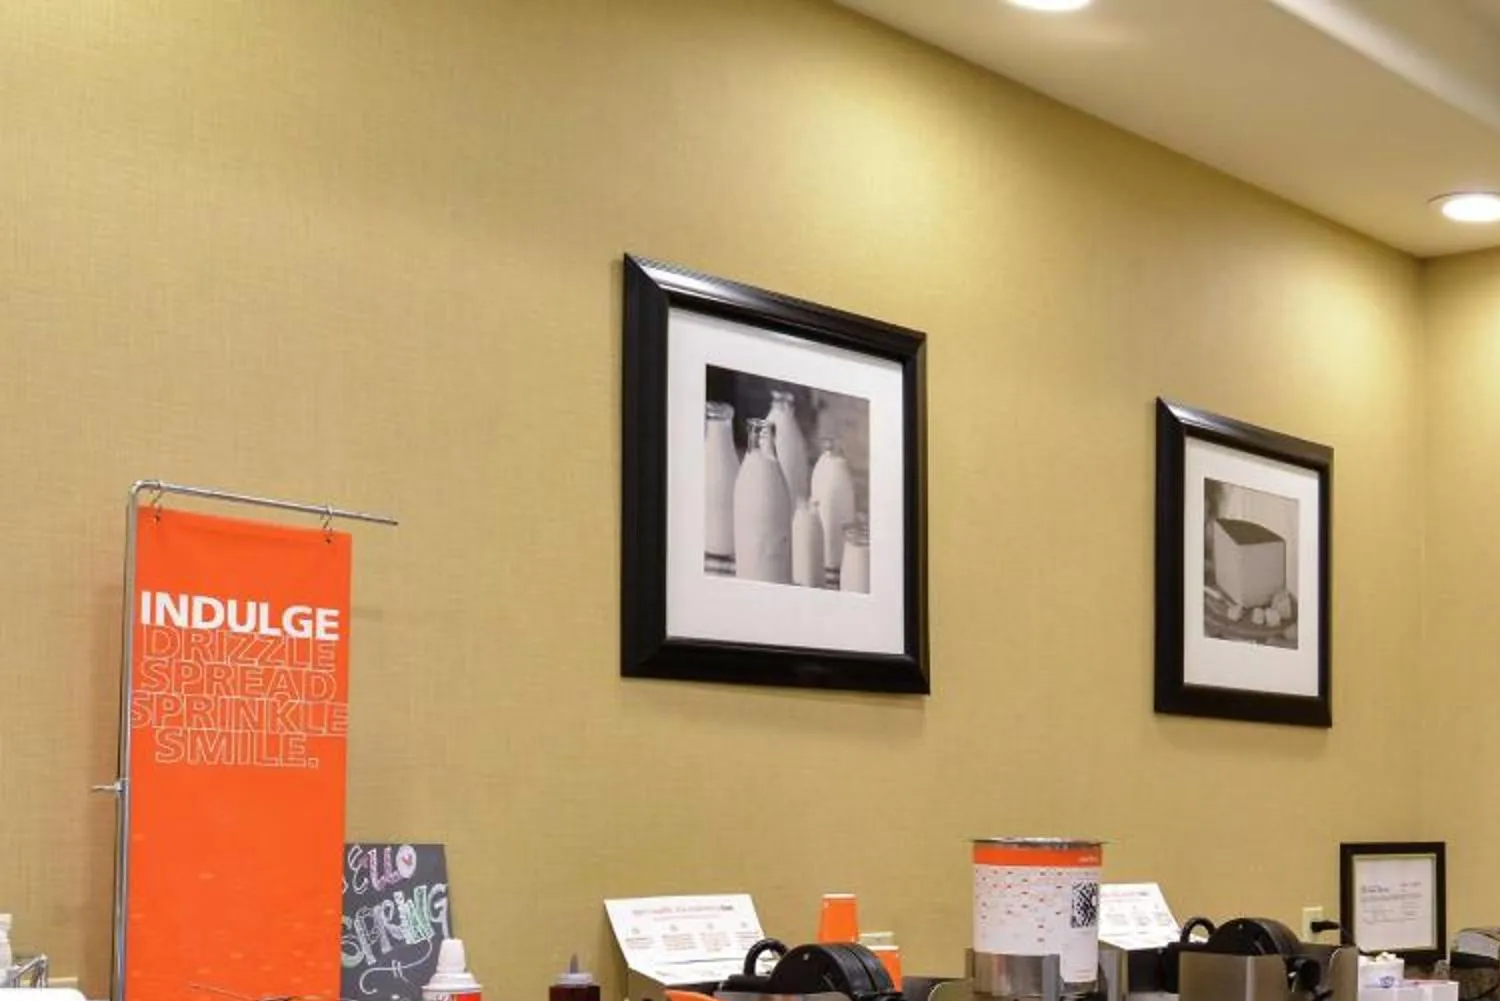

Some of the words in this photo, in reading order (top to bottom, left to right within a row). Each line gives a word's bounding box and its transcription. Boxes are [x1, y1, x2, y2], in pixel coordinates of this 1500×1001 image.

[141, 591, 340, 640] INDULGE
[143, 626, 336, 672] DRIZZLE
[140, 659, 337, 702] SPREAD
[131, 690, 348, 735] SPRINKLE
[155, 728, 319, 769] SMILE.
[341, 845, 416, 894] ELLO
